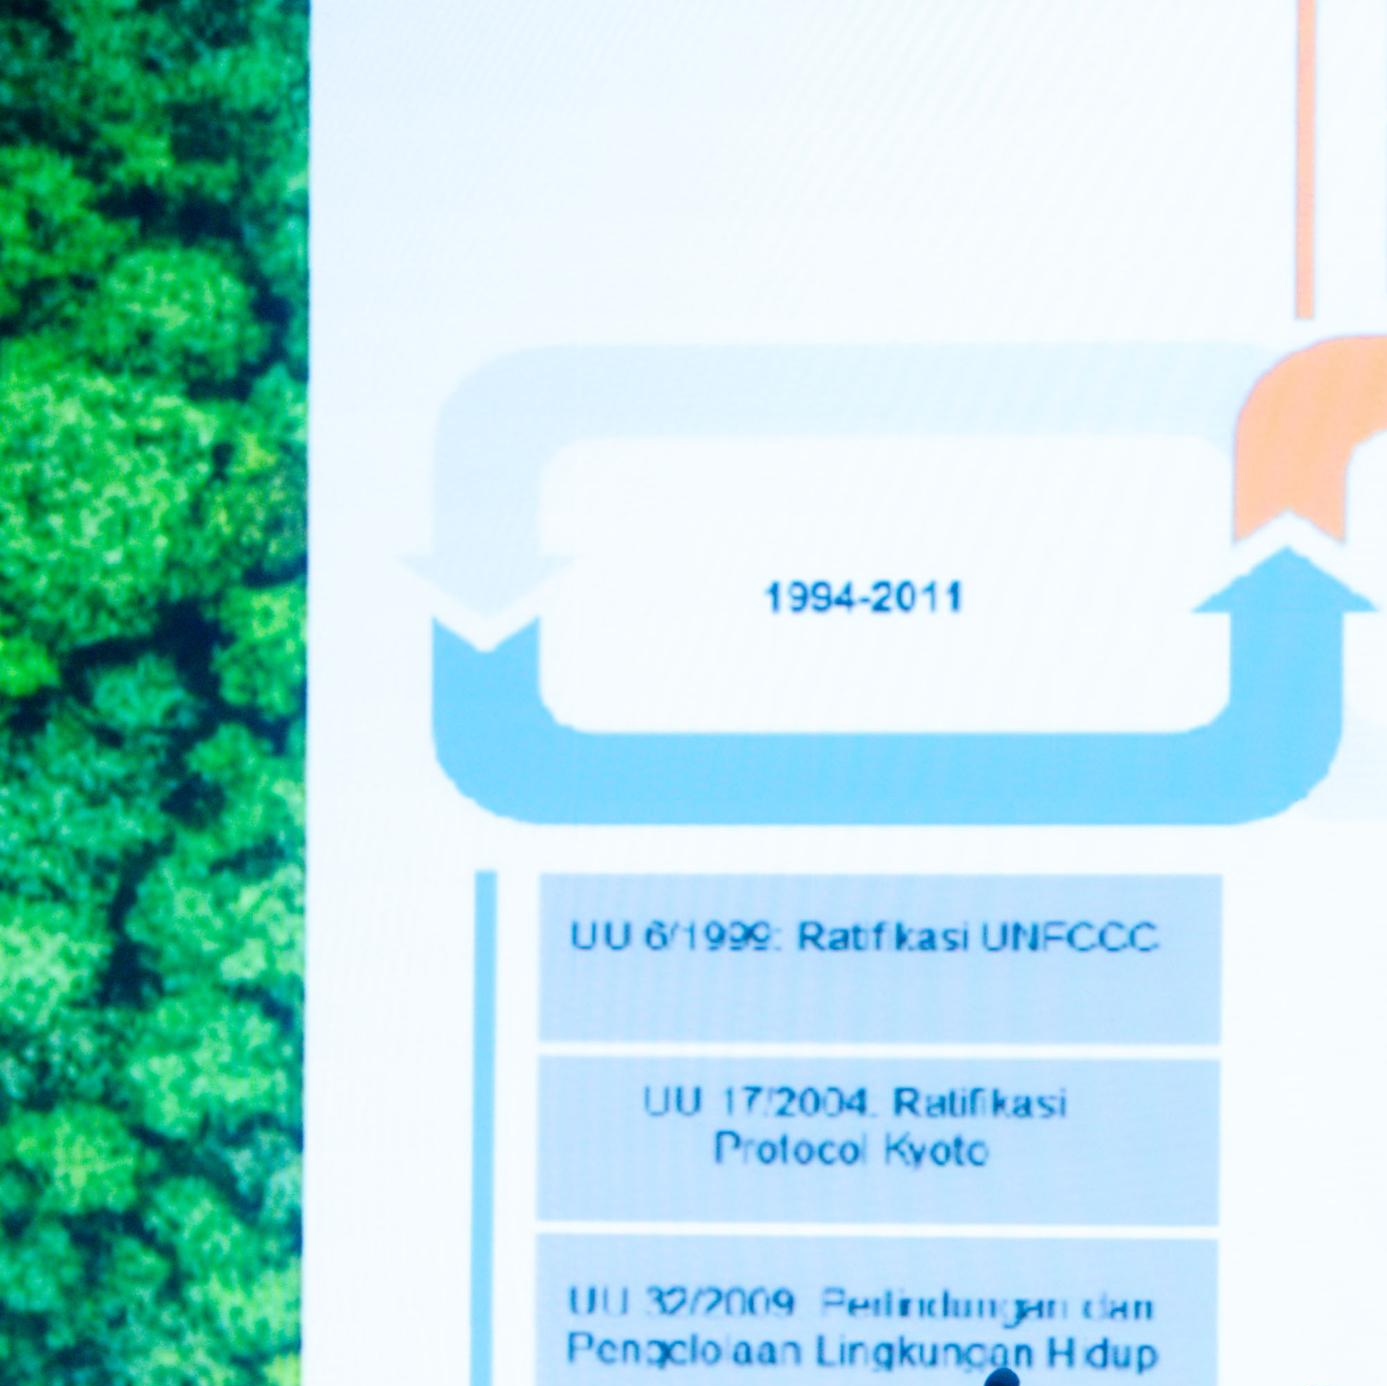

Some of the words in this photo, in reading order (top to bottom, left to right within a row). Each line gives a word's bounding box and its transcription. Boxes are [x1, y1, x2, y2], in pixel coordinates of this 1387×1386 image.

[766, 579, 961, 614] 1994-2011
[570, 920, 632, 951] UU
[797, 919, 969, 952] Ratifikasi
[981, 920, 1160, 953] UNFCCC
[644, 1085, 702, 1117] UU
[892, 1085, 1068, 1119] Ratifikasi
[714, 1129, 868, 1166] Protocol
[884, 1132, 990, 1172] Kyoto
[568, 1284, 629, 1316] UU
[822, 1286, 1070, 1330] Perlindungan
[1081, 1290, 1154, 1321] dan
[566, 1330, 802, 1370] Pengelolaan
[815, 1333, 1034, 1373] Lingkungan
[1046, 1335, 1160, 1375] Hidup
